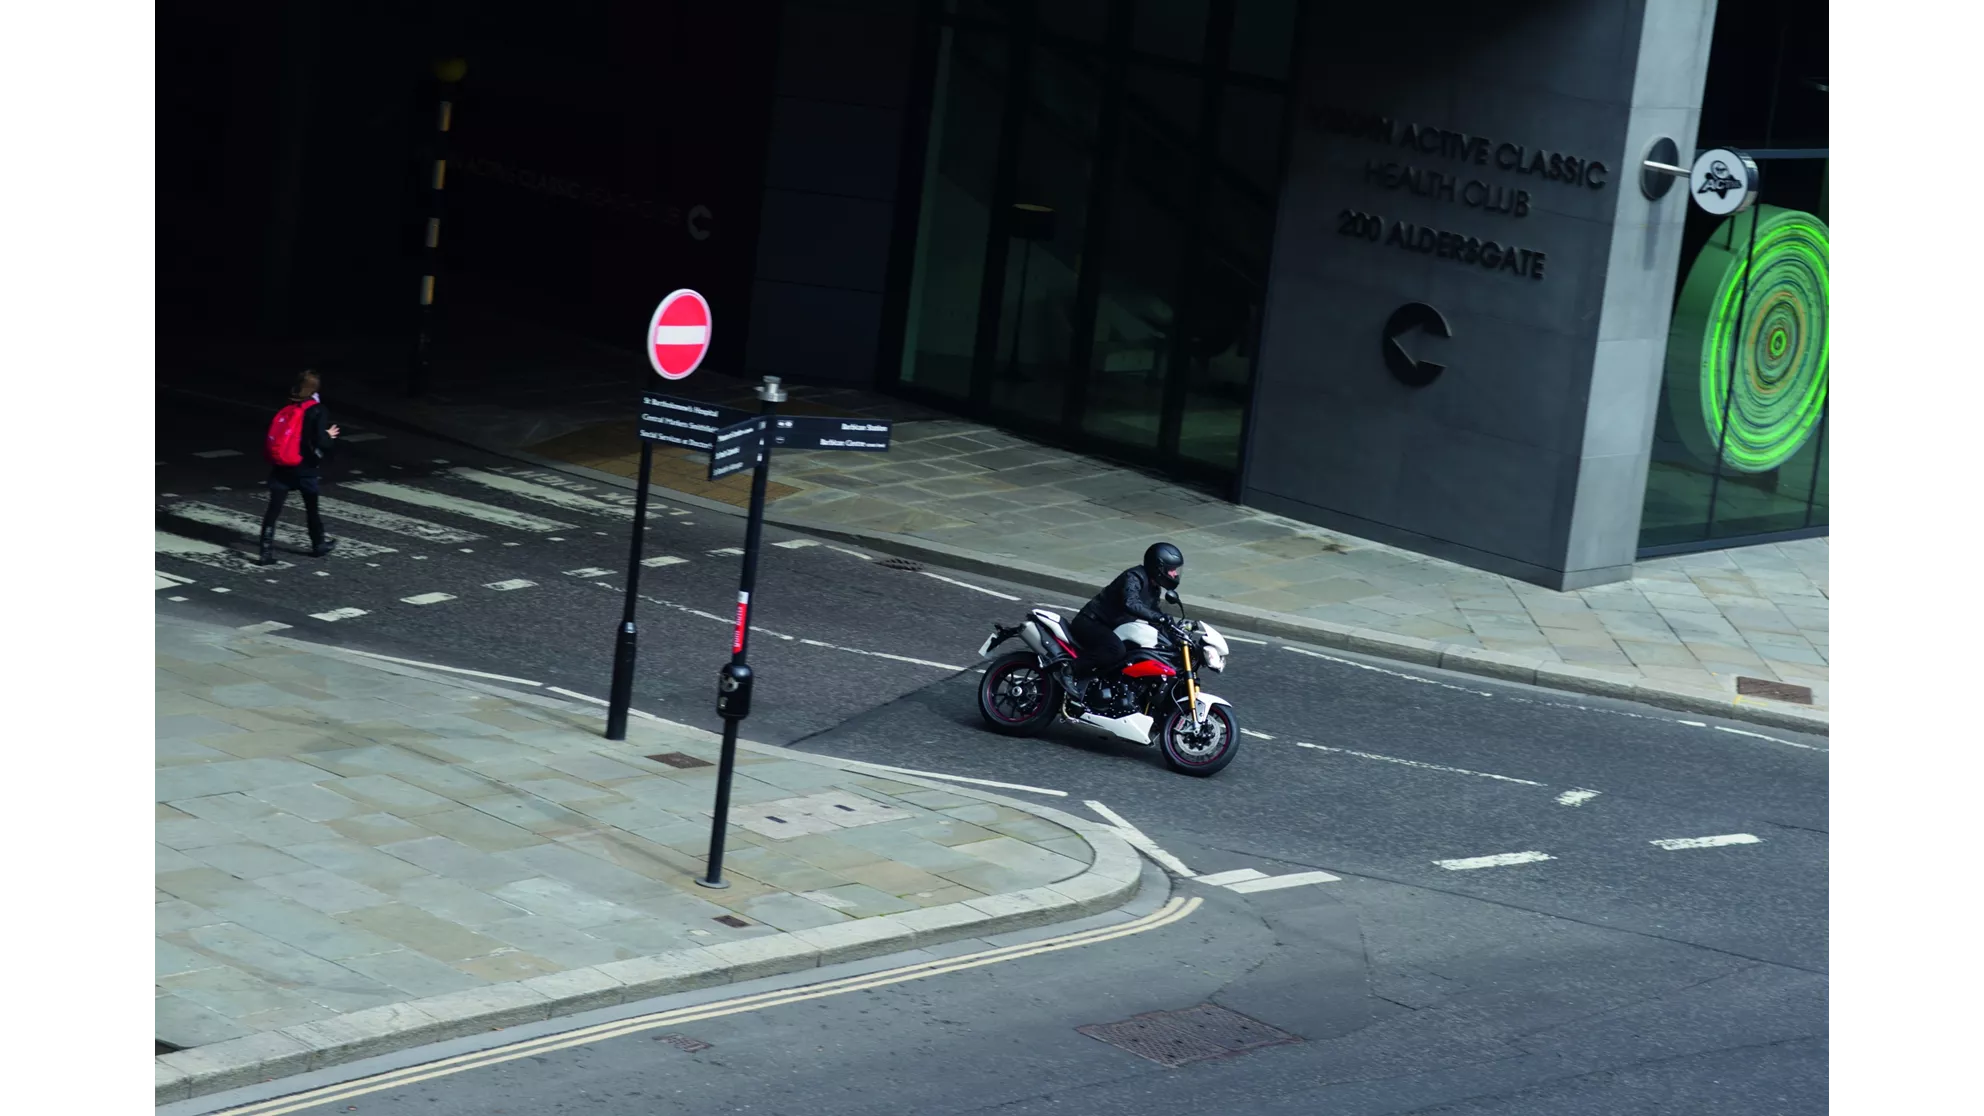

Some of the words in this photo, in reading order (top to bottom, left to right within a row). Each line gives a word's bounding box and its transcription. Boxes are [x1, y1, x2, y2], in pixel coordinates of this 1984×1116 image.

[1399, 123, 1491, 166] ACTIVE
[1495, 142, 1609, 190] CLASSIC
[1364, 159, 1457, 203] HEALTH
[1463, 180, 1531, 218] CLUB
[1337, 208, 1383, 243] 200
[1386, 220, 1547, 281] ALDERSGATE
[484, 466, 598, 492] RIGHT
[595, 491, 693, 516] LOOK
